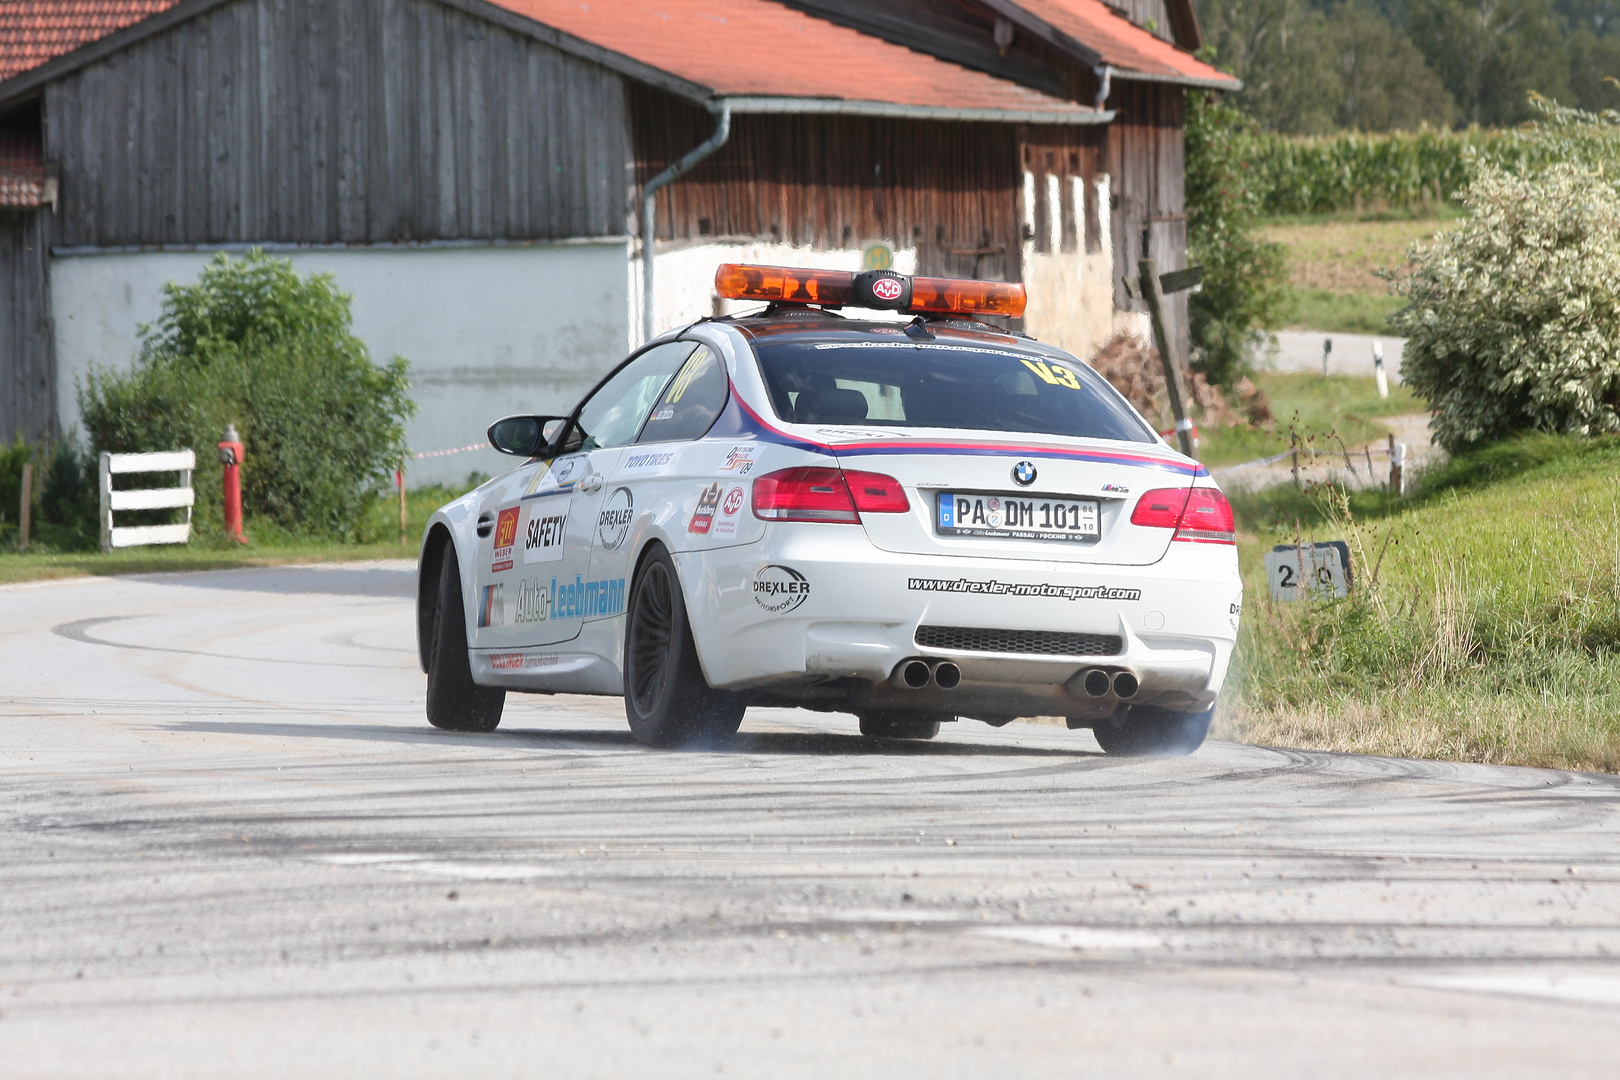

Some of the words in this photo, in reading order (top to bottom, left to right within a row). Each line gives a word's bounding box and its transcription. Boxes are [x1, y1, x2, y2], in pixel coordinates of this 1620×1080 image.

[1020, 359, 1081, 389] V3
[943, 513, 950, 522] D
[956, 498, 986, 525] PA
[1004, 500, 1034, 527] DM
[1039, 503, 1081, 530] 101
[1082, 505, 1094, 514] 04
[599, 508, 633, 530] DREXLER
[1083, 523, 1094, 531] 10
[525, 514, 567, 550] SAFETY
[494, 547, 512, 559] WEBER
[753, 581, 810, 596] DREXLER
[908, 578, 1141, 601] www.drexler-motorsport.com
